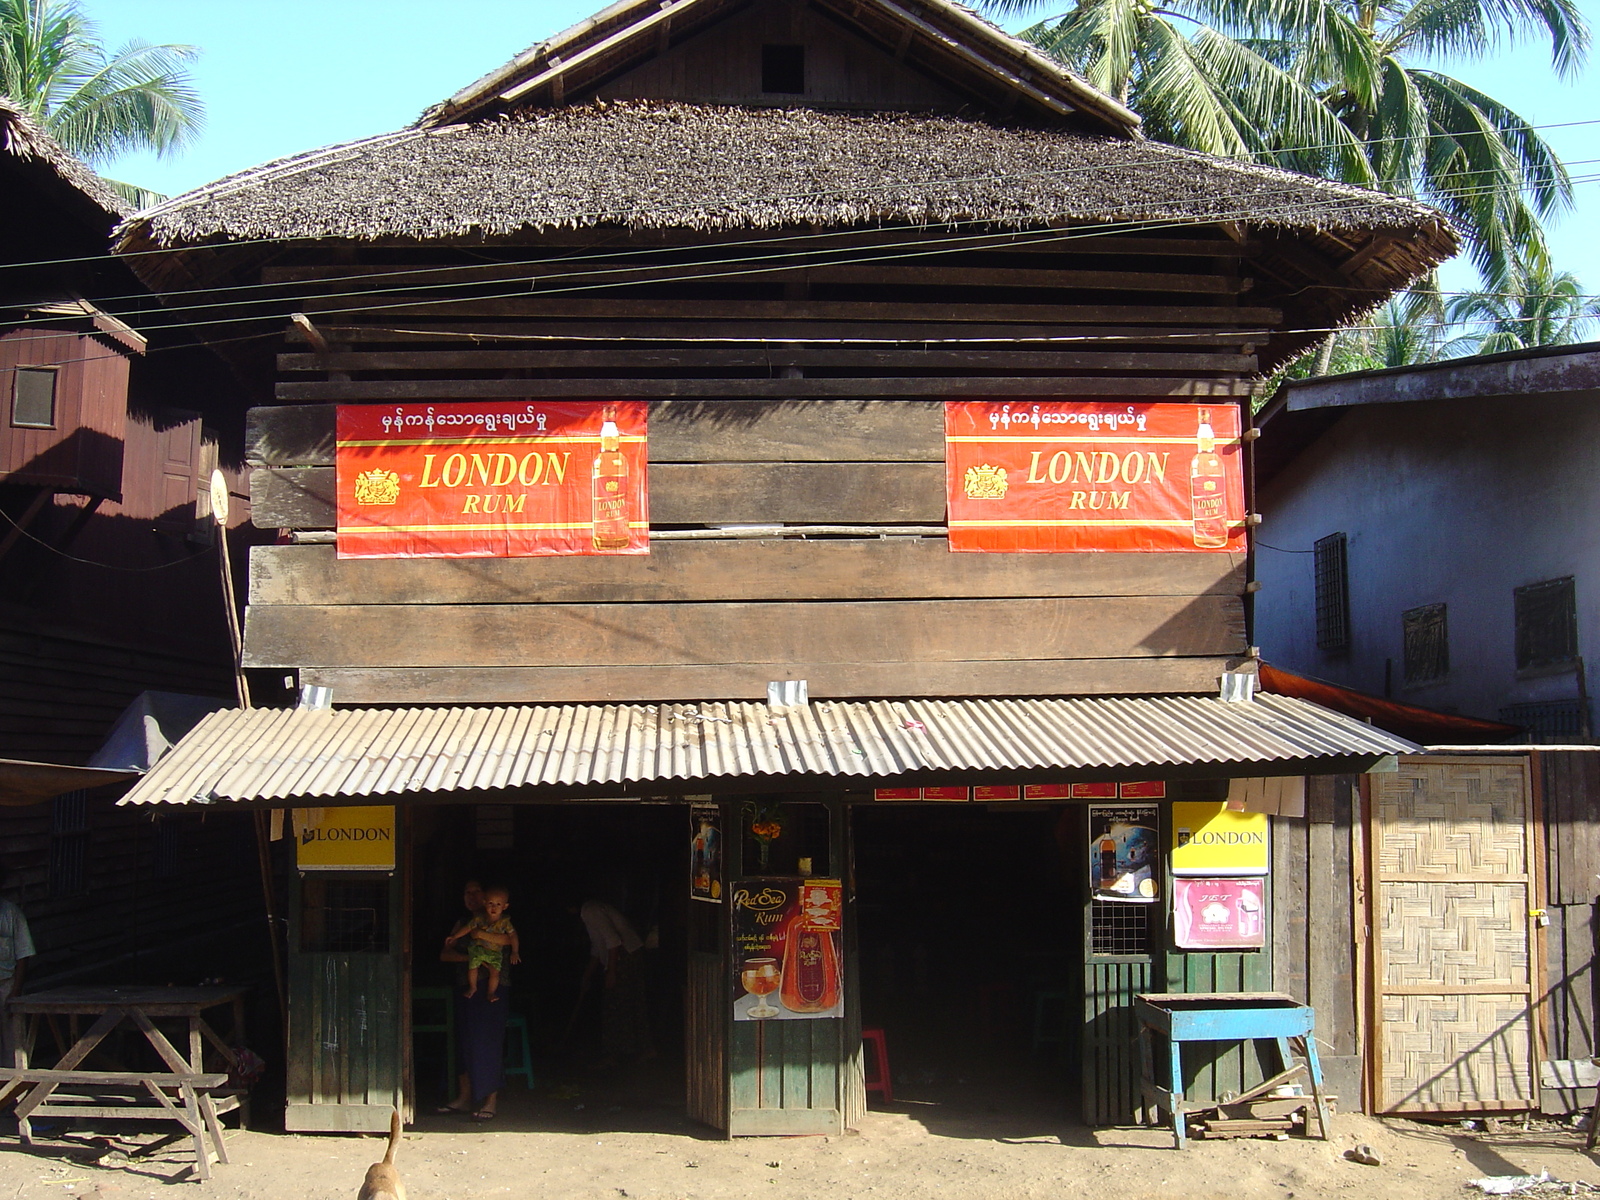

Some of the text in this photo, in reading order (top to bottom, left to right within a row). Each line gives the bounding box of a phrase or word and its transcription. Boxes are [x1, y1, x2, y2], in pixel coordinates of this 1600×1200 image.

[418, 452, 571, 488] LONDON
[1026, 451, 1171, 485] LONDON
[461, 494, 528, 514] RUM
[598, 498, 625, 511] LONDON
[1068, 491, 1131, 510] RUM
[1197, 498, 1222, 509] LONDON
[605, 510, 620, 518] RUM
[1204, 508, 1218, 516] RUM
[317, 828, 390, 841] LONDON
[1193, 831, 1263, 844] LONDON
[734, 887, 786, 906] Red Sea
[1198, 894, 1233, 902] JET
[754, 911, 784, 926] Rum
